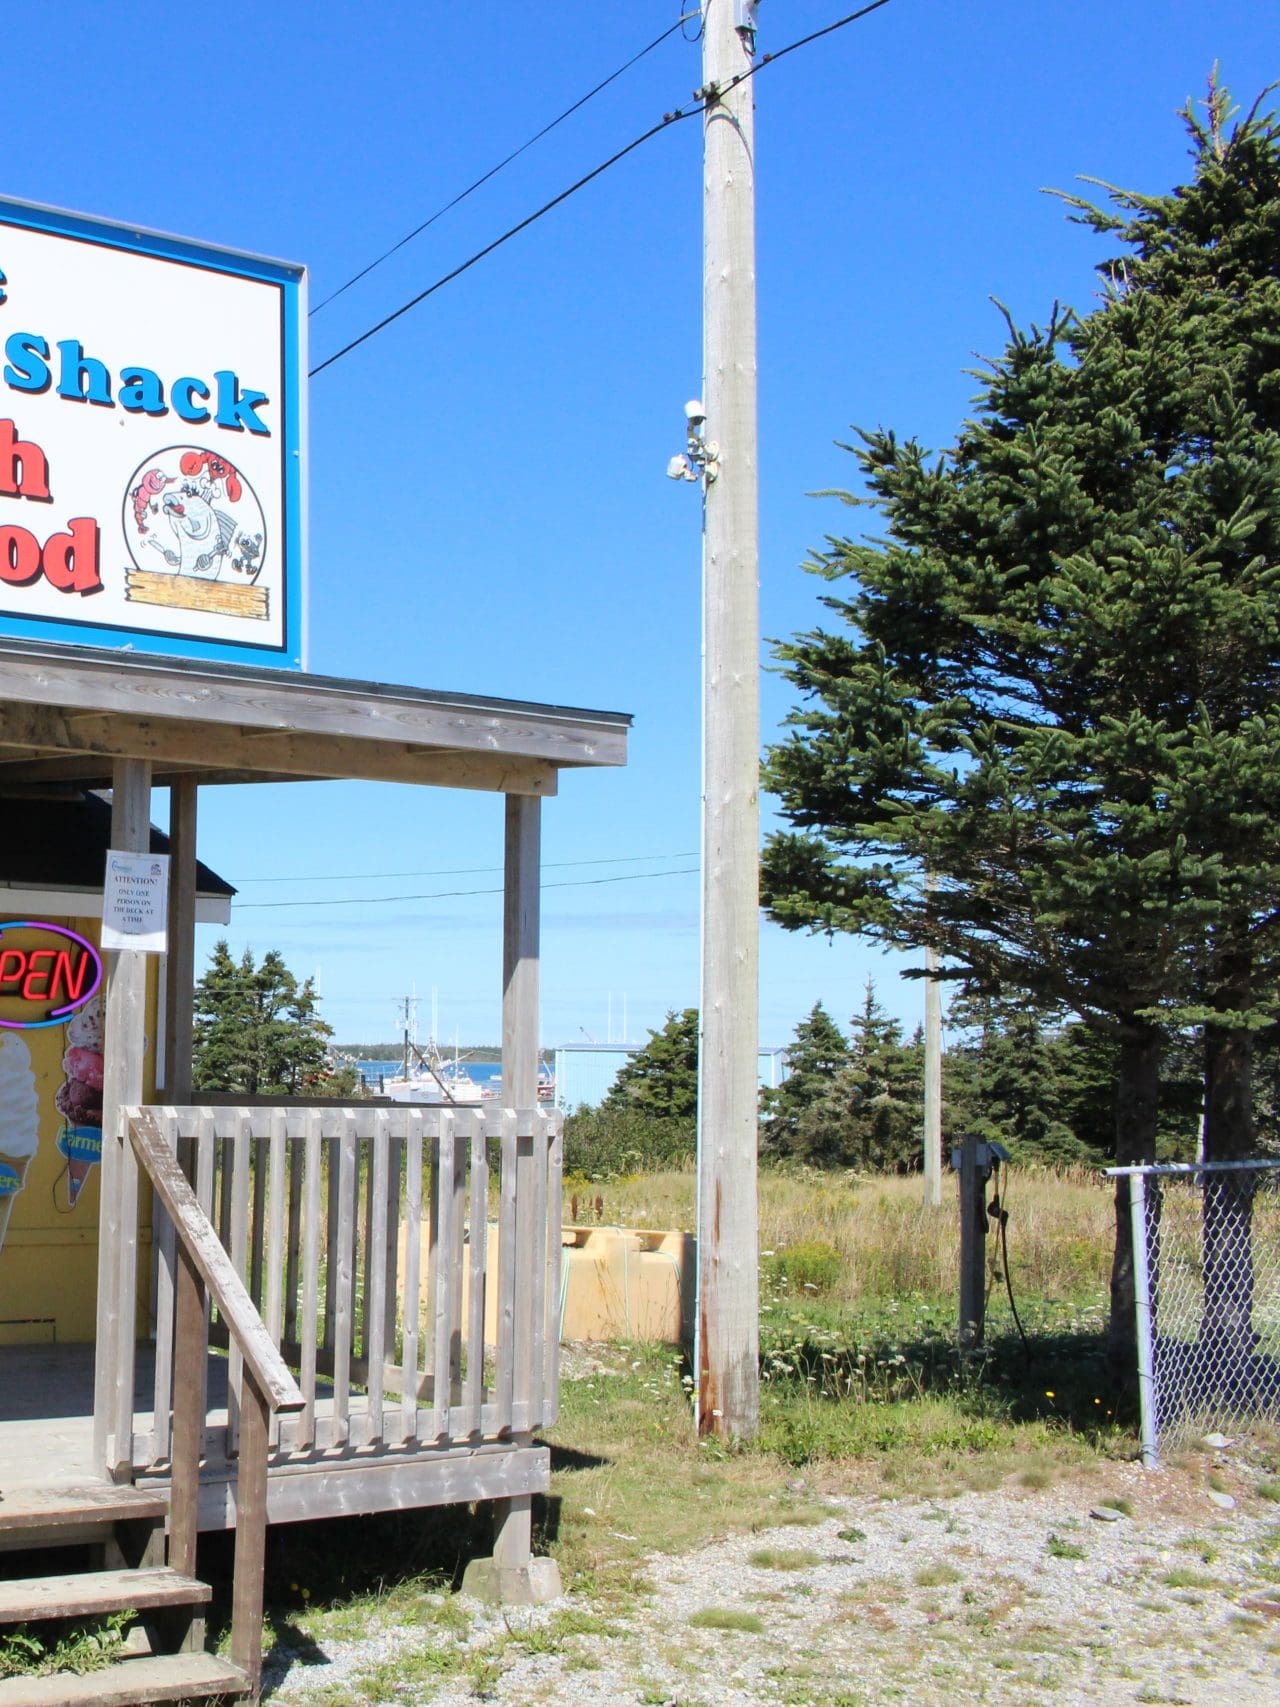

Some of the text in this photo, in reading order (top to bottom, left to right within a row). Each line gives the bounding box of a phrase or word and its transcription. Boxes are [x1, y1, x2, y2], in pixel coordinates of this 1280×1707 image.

[4, 331, 272, 436] Shack
[115, 875, 158, 885] ATTENTION!
[135, 889, 150, 897] ONE
[58, 1125, 103, 1153] Farme
